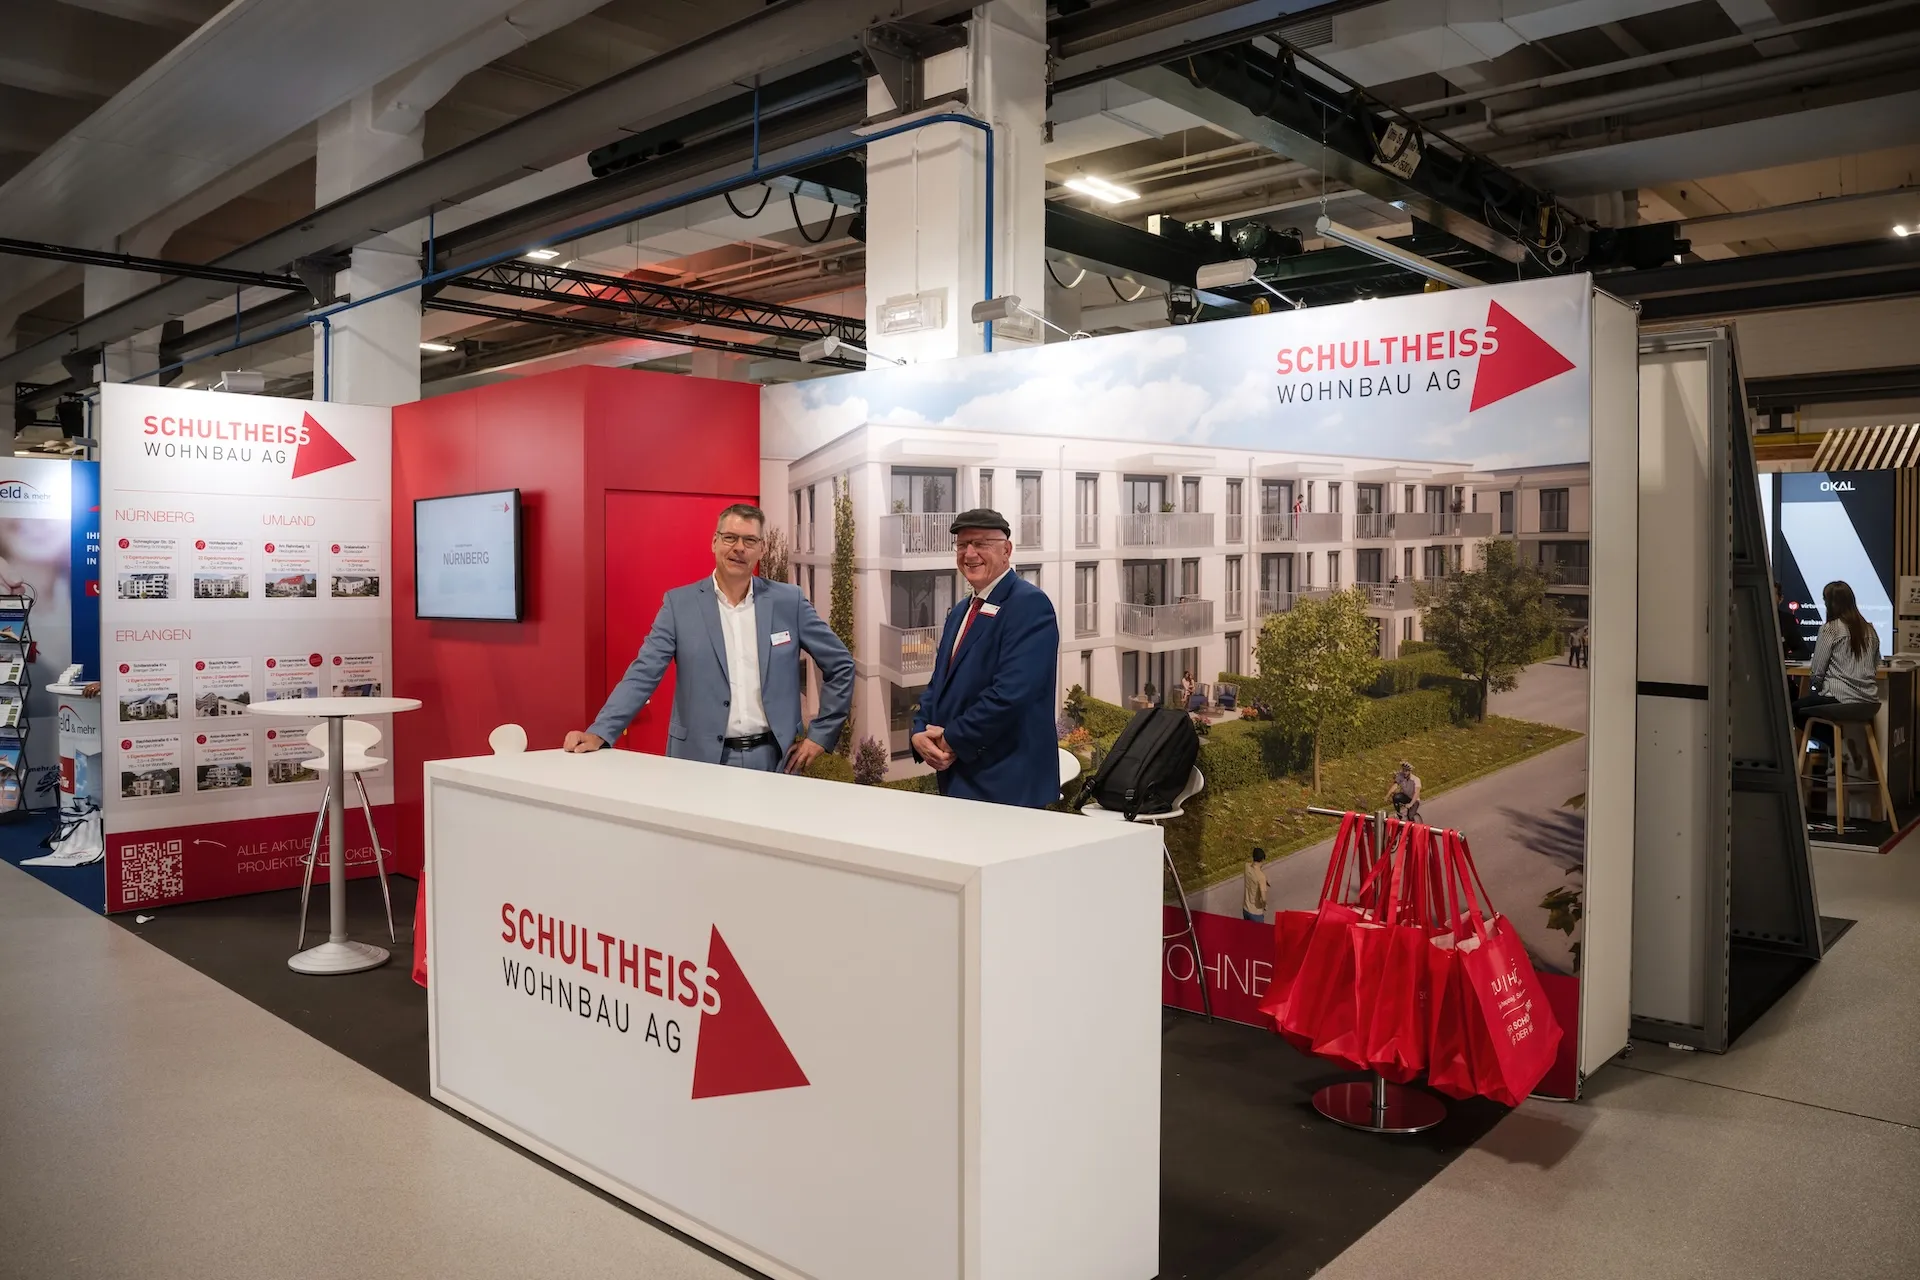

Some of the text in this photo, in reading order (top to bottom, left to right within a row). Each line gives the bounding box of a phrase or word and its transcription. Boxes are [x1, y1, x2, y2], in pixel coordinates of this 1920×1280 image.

[1276, 325, 1501, 375] SCHULTHEISS
[1276, 369, 1461, 404] WOHNBAU AG
[144, 415, 311, 445] SCHULTHEISS
[144, 442, 286, 464] WOHNBAU AG
[1820, 481, 1856, 492] OKAL
[115, 507, 195, 524] NÜRNBERG
[262, 514, 316, 527] UMLAND
[443, 549, 489, 565] NÜRNBERG
[115, 629, 192, 642] ERLANGEN
[71, 723, 76, 733] &
[77, 725, 96, 735] mehr
[236, 842, 268, 857] ALLE
[237, 855, 302, 874] PROJEKTE
[501, 903, 723, 1016] SCHULTHEISS
[502, 956, 682, 1054] WOHNBAU AG
